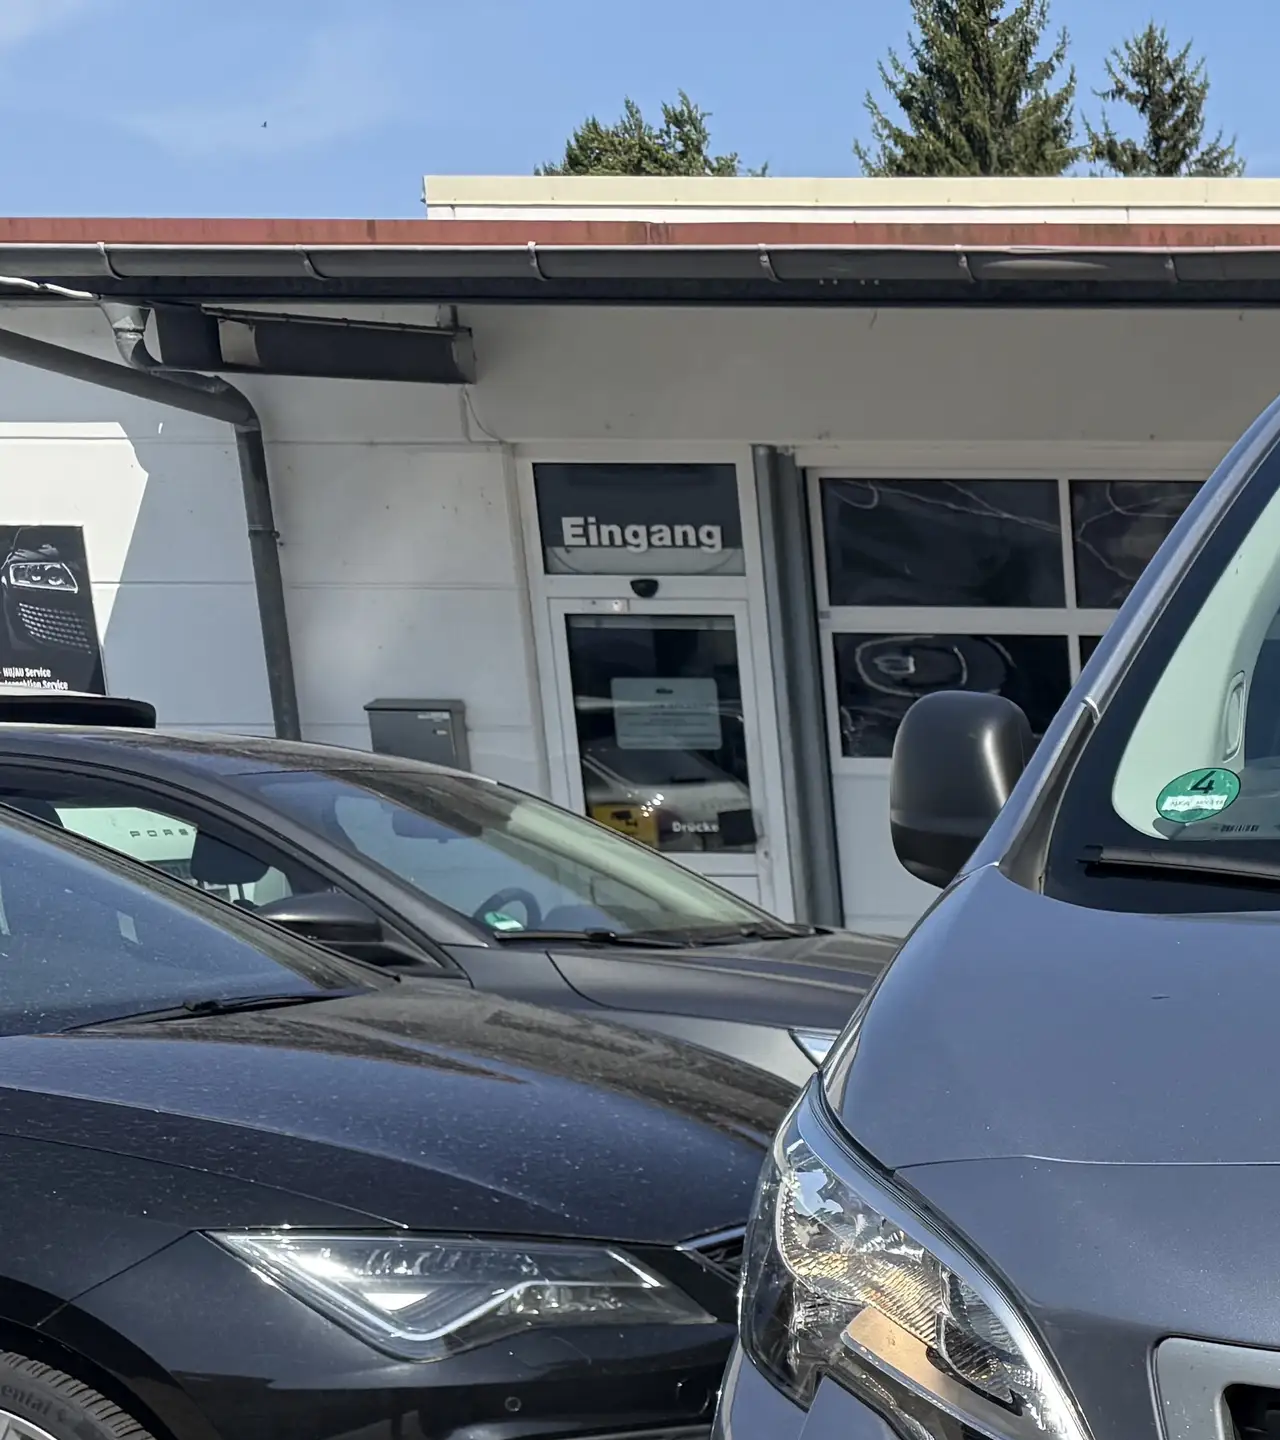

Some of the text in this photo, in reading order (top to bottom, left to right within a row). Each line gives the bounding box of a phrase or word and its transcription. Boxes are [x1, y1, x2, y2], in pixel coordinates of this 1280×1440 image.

[562, 516, 722, 553] Eingang
[25, 666, 51, 678] Service
[1190, 770, 1217, 793] 4
